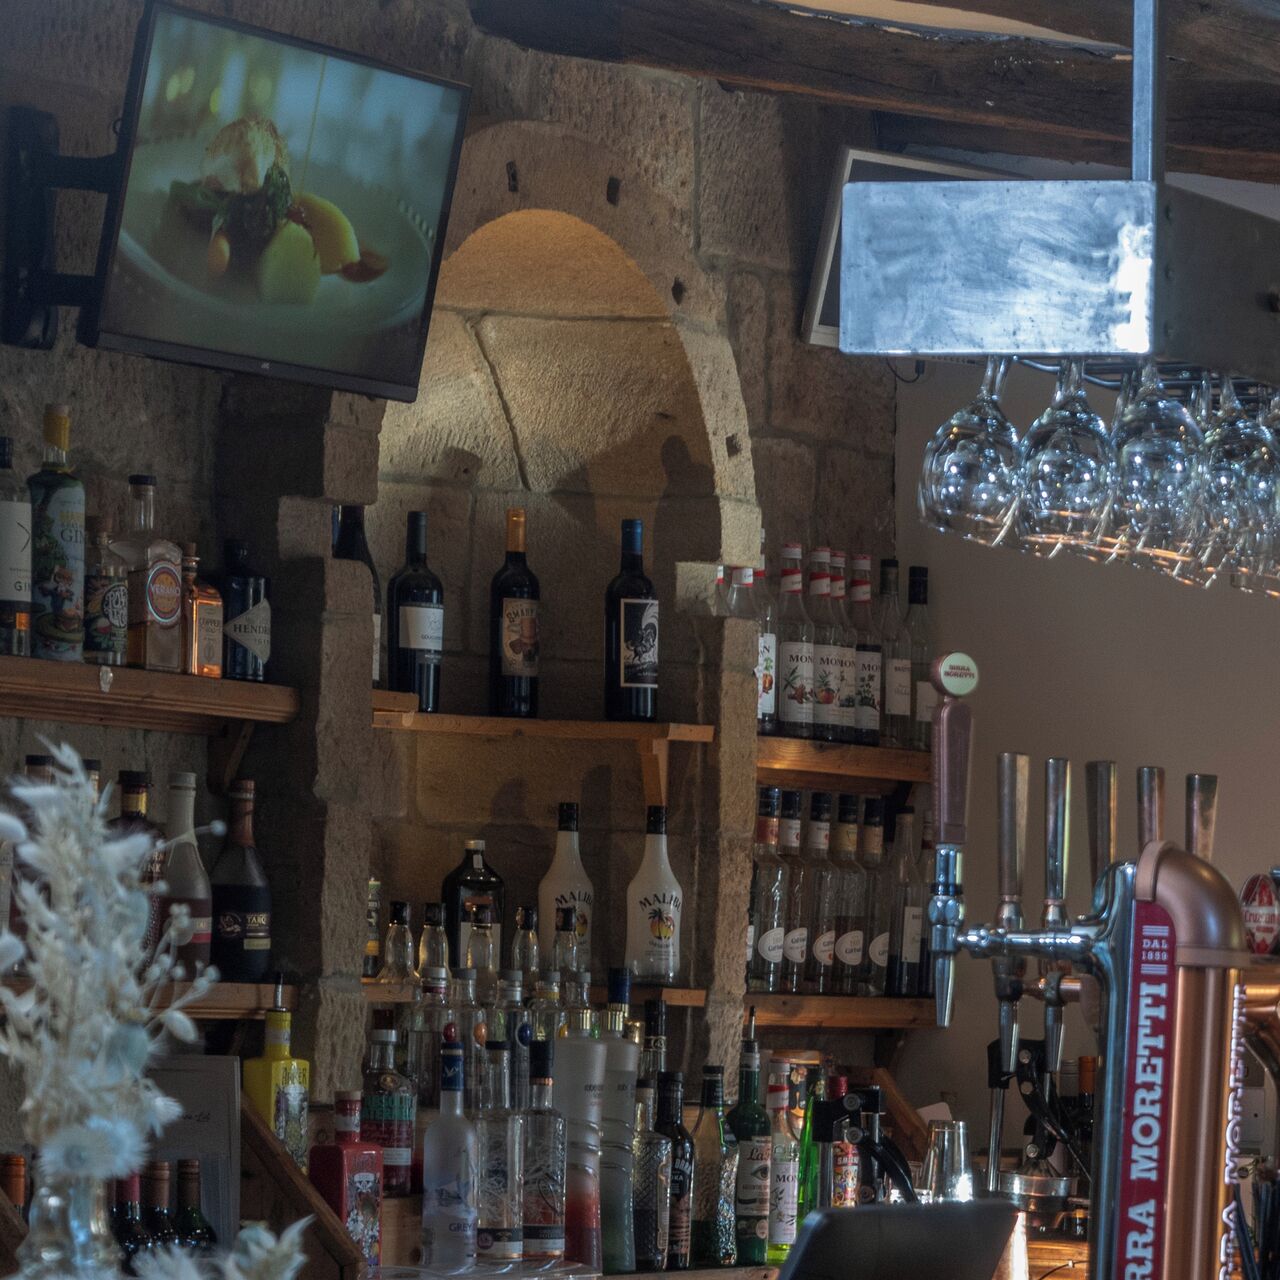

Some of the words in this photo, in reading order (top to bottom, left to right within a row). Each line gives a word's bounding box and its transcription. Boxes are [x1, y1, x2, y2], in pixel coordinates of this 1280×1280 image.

[1142, 938, 1169, 950] DAL
[1141, 950, 1169, 962] 1859
[1130, 982, 1168, 1181] MORETTI
